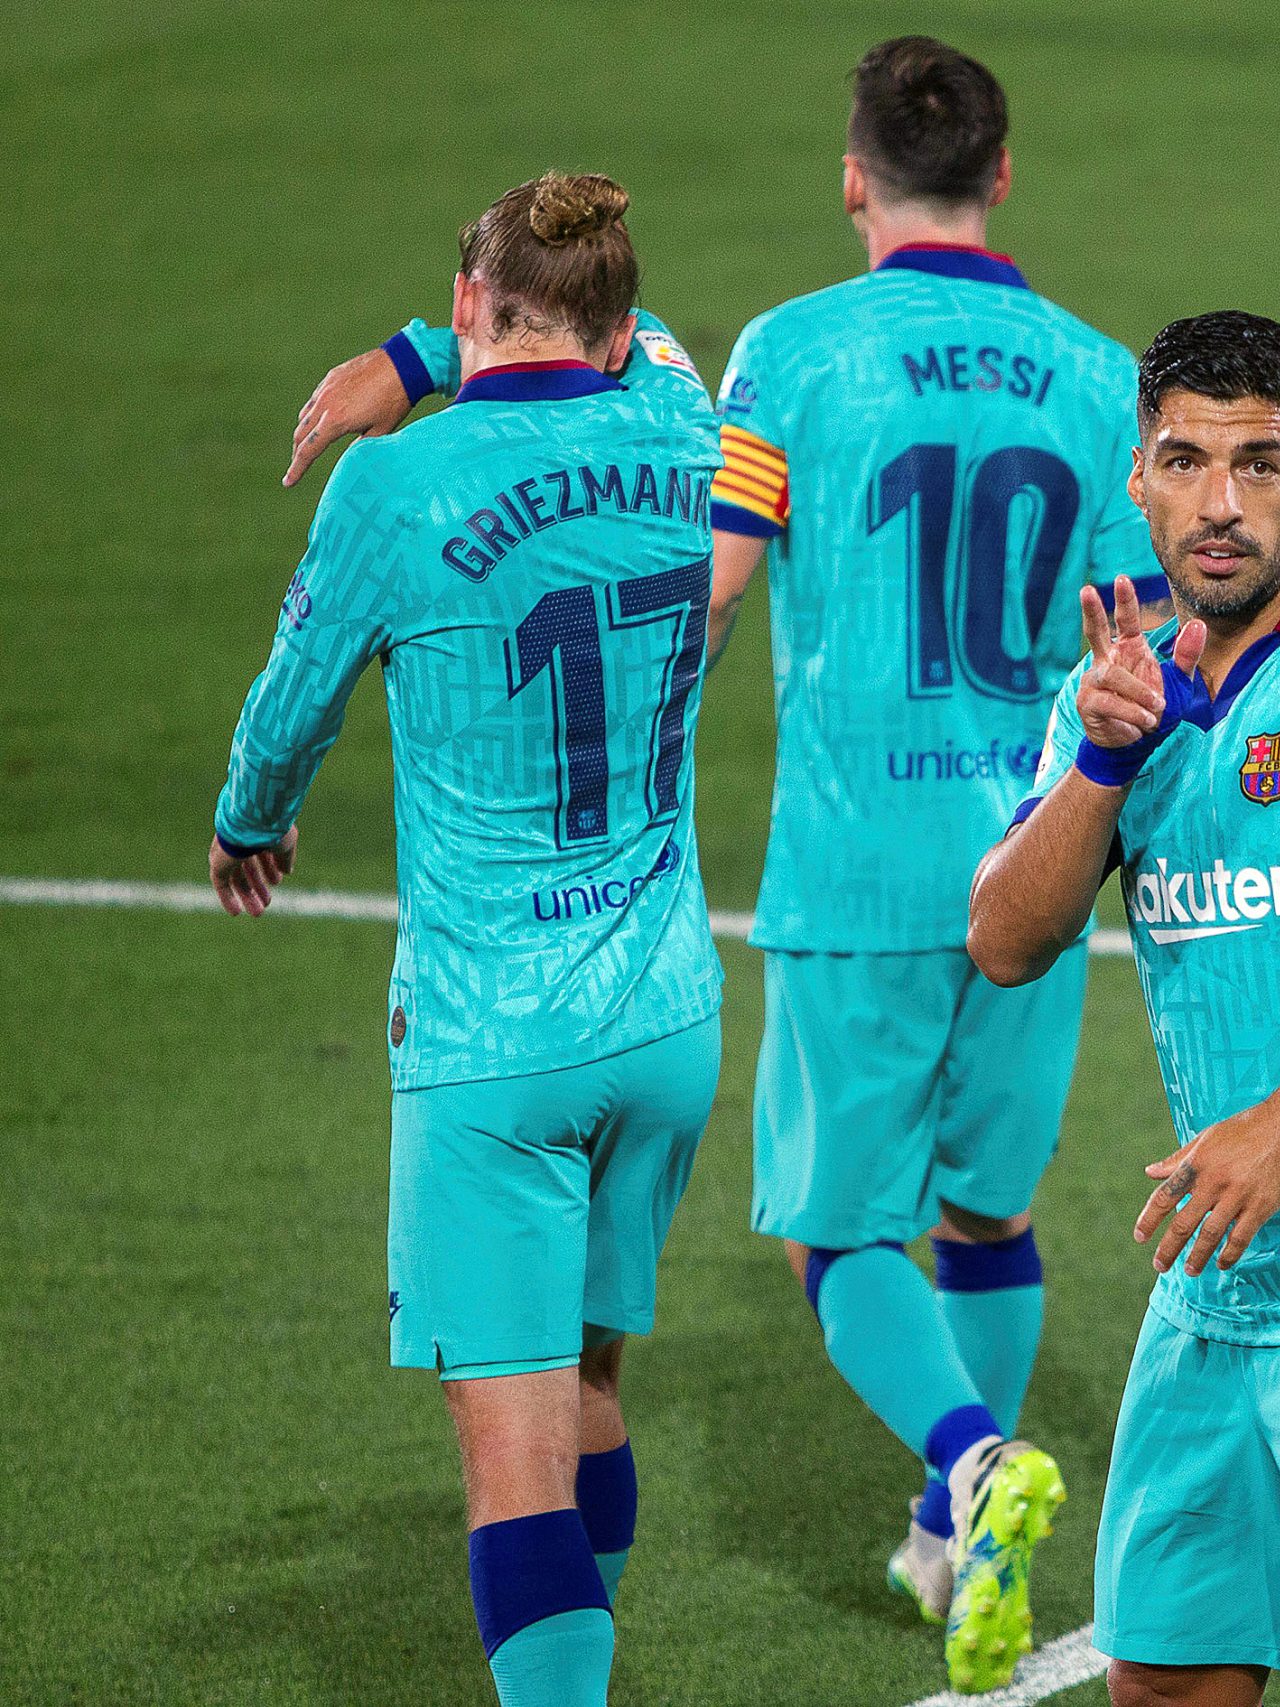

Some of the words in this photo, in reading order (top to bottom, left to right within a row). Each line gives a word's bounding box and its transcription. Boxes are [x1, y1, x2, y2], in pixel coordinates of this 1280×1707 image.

[902, 345, 1055, 408] MESSI
[866, 442, 1082, 702] 10
[507, 558, 712, 852] 17
[888, 739, 1001, 781] unicef
[1258, 761, 1280, 772] FCB
[532, 874, 647, 922] unic
